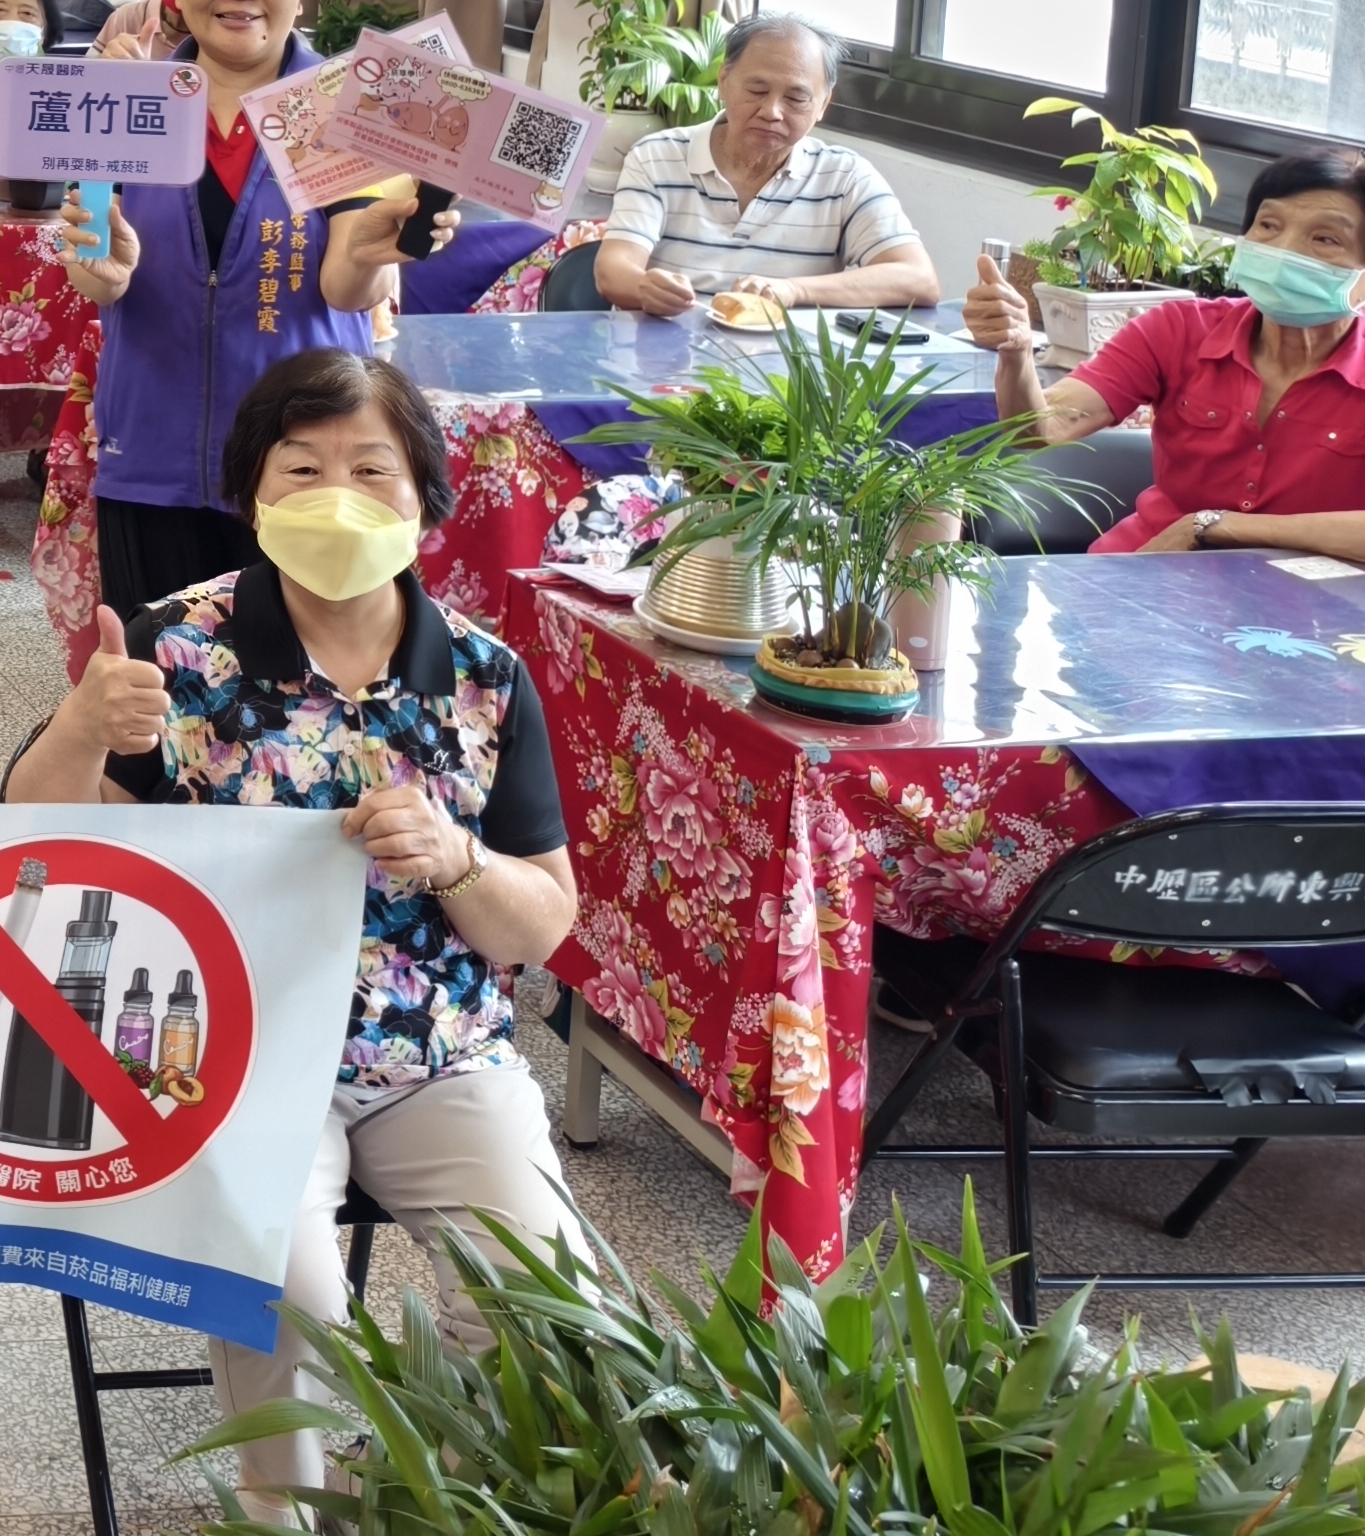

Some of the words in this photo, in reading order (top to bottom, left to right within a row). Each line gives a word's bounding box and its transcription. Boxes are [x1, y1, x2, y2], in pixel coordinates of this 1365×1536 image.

[28, 90, 169, 136] 蘆竹區
[41, 156, 149, 174] 別再耍肺-戒菸班
[55, 1156, 139, 1195] 關心您
